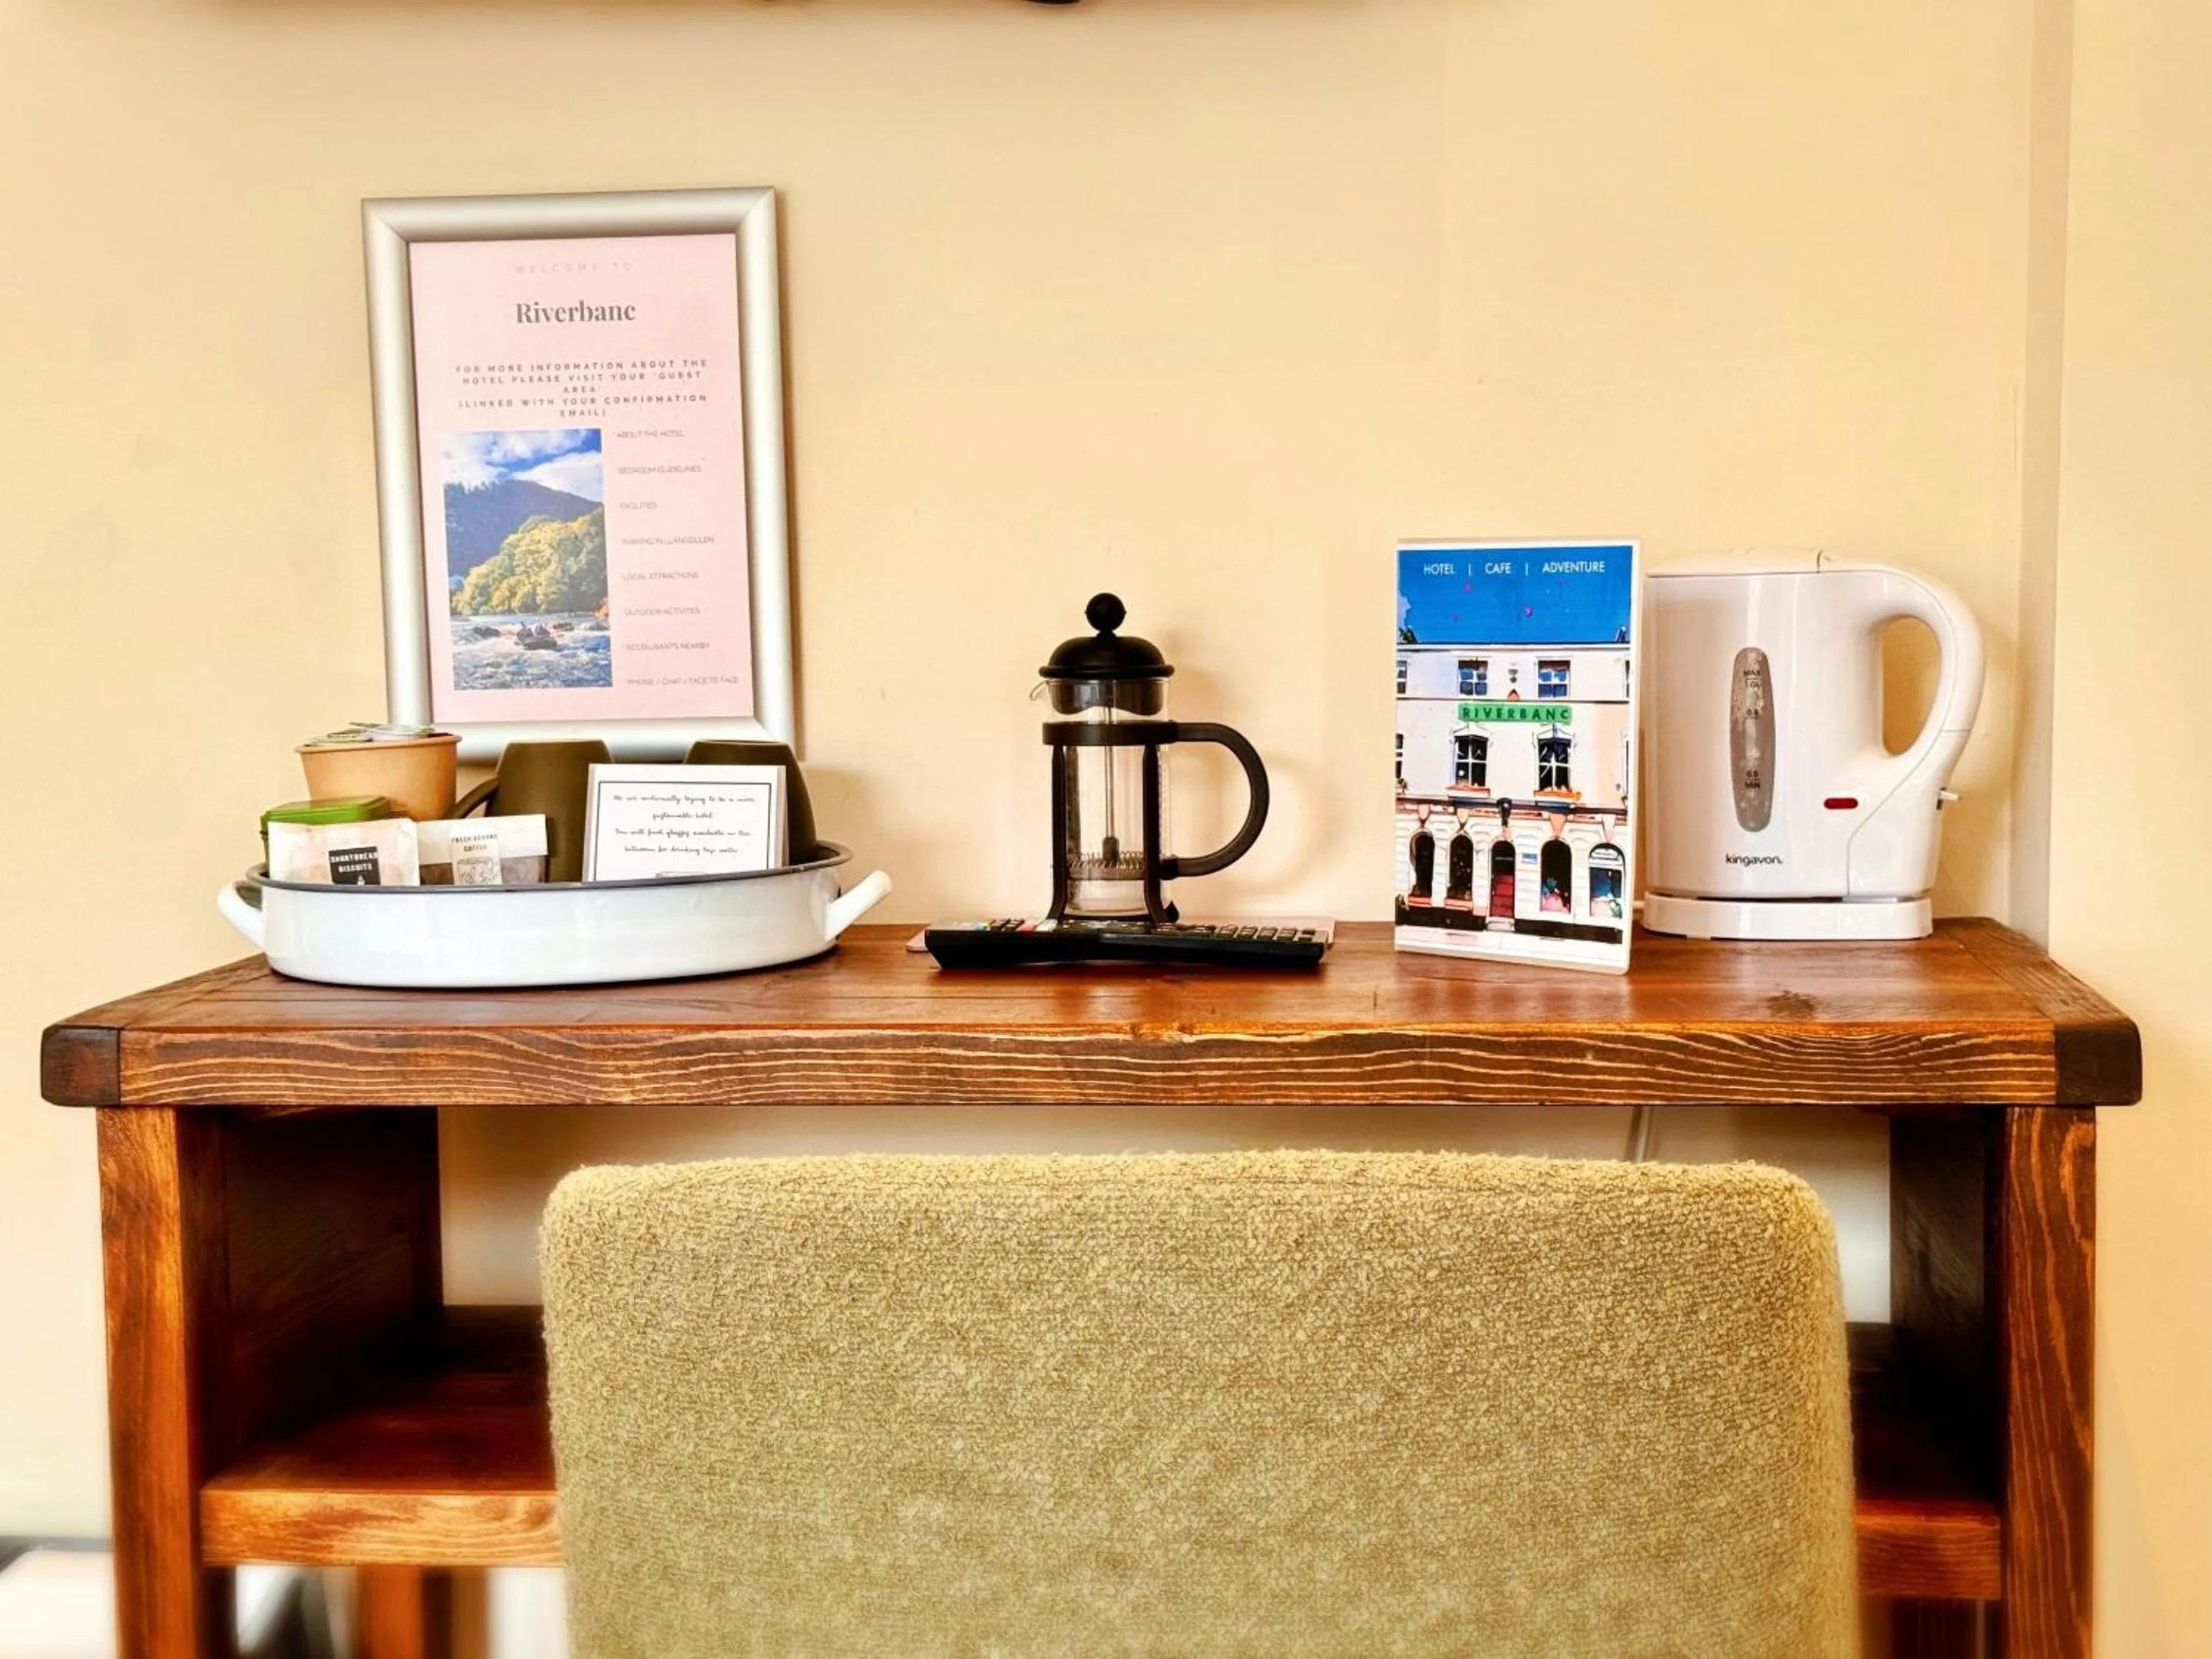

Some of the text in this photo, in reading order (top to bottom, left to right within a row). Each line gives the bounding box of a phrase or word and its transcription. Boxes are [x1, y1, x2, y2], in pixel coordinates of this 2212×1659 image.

[516, 299, 636, 324] Riverbanc
[488, 364, 523, 372] MORE
[531, 362, 623, 372] INFORMATION
[631, 360, 674, 368] ABOUT
[462, 376, 504, 385] HOTEL
[511, 375, 560, 383] PLEASE
[568, 373, 603, 382] VISIT
[611, 372, 645, 381] YOUR
[521, 398, 554, 407] WITH
[562, 397, 597, 405] YOUR
[603, 395, 707, 405] CONFIRMATION
[1423, 563, 1456, 575] HOTEL
[1485, 562, 1511, 574] CAFE
[1542, 561, 1605, 573] ADVENTURE
[1462, 706, 1569, 720] RIVERBANC
